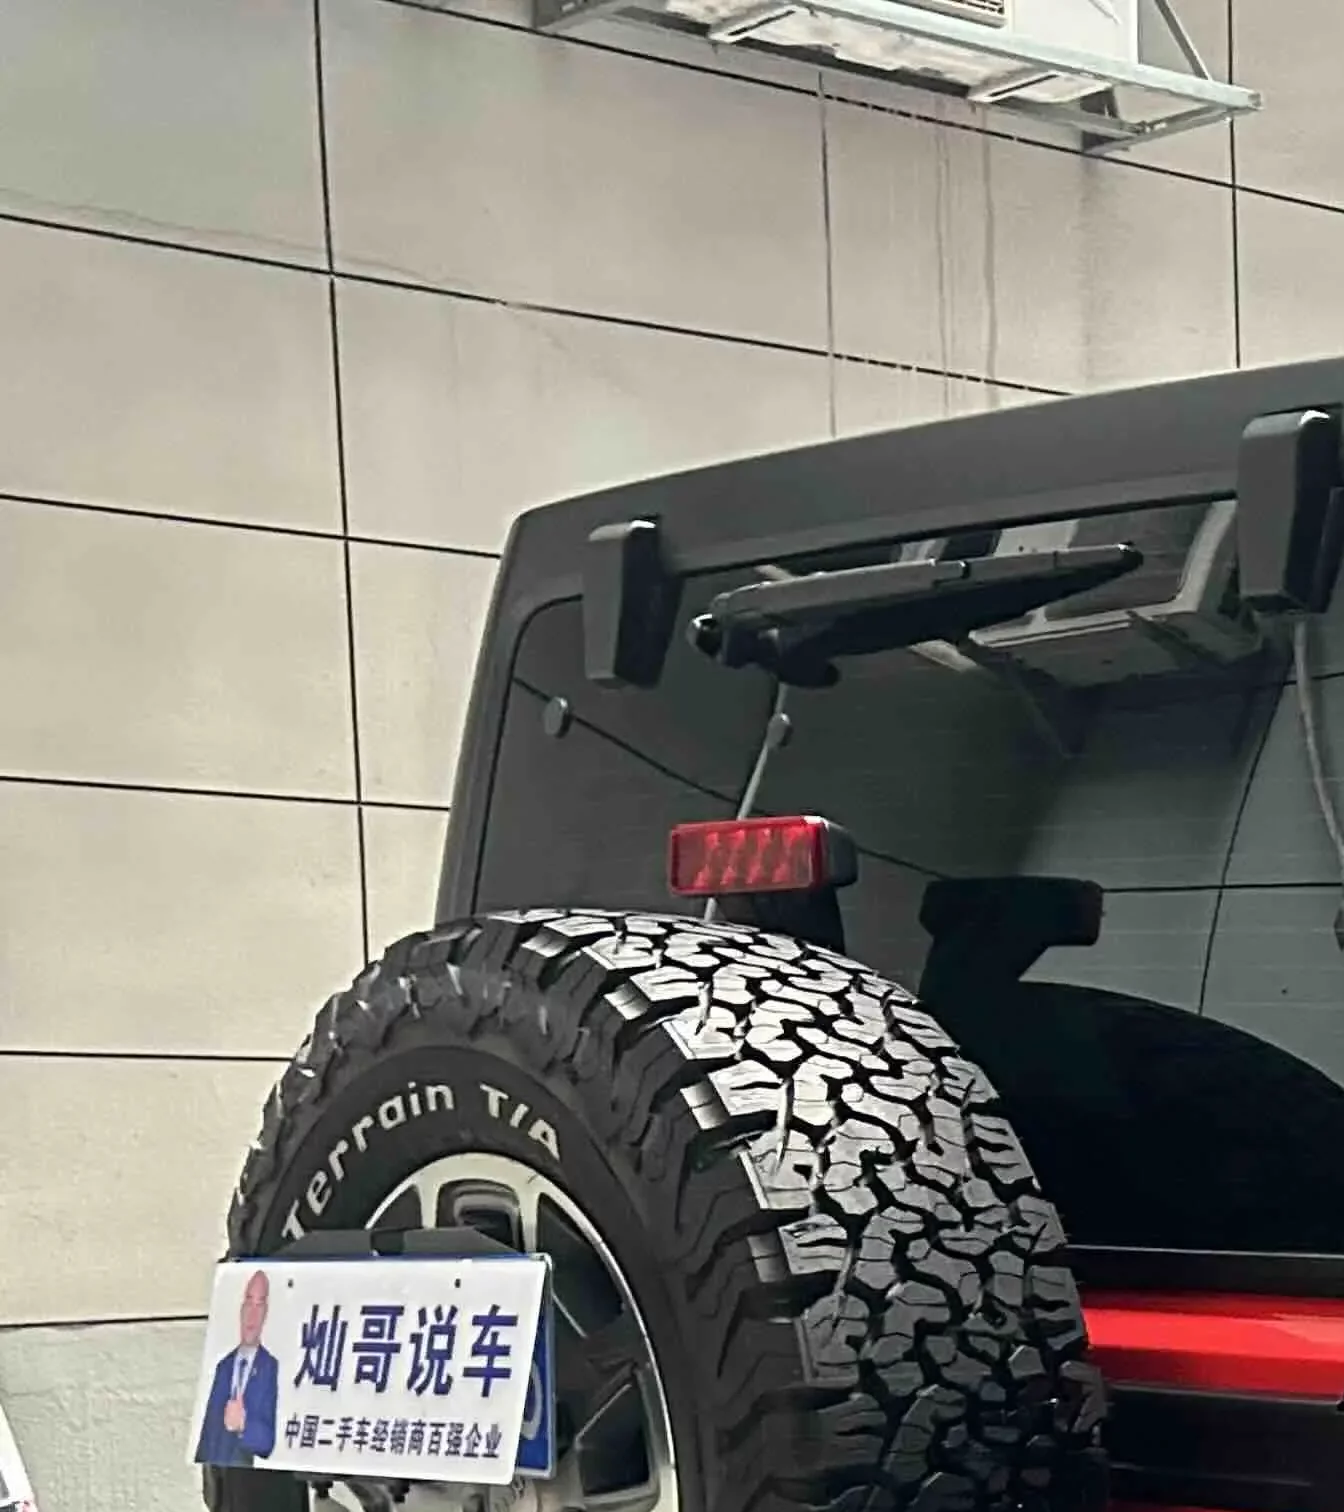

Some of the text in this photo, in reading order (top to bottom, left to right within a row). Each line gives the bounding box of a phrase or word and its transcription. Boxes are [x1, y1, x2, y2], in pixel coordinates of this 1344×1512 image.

[293, 1304, 519, 1398] 灿哥说车
[284, 1412, 502, 1459] 中国二手车经销商百强企业
